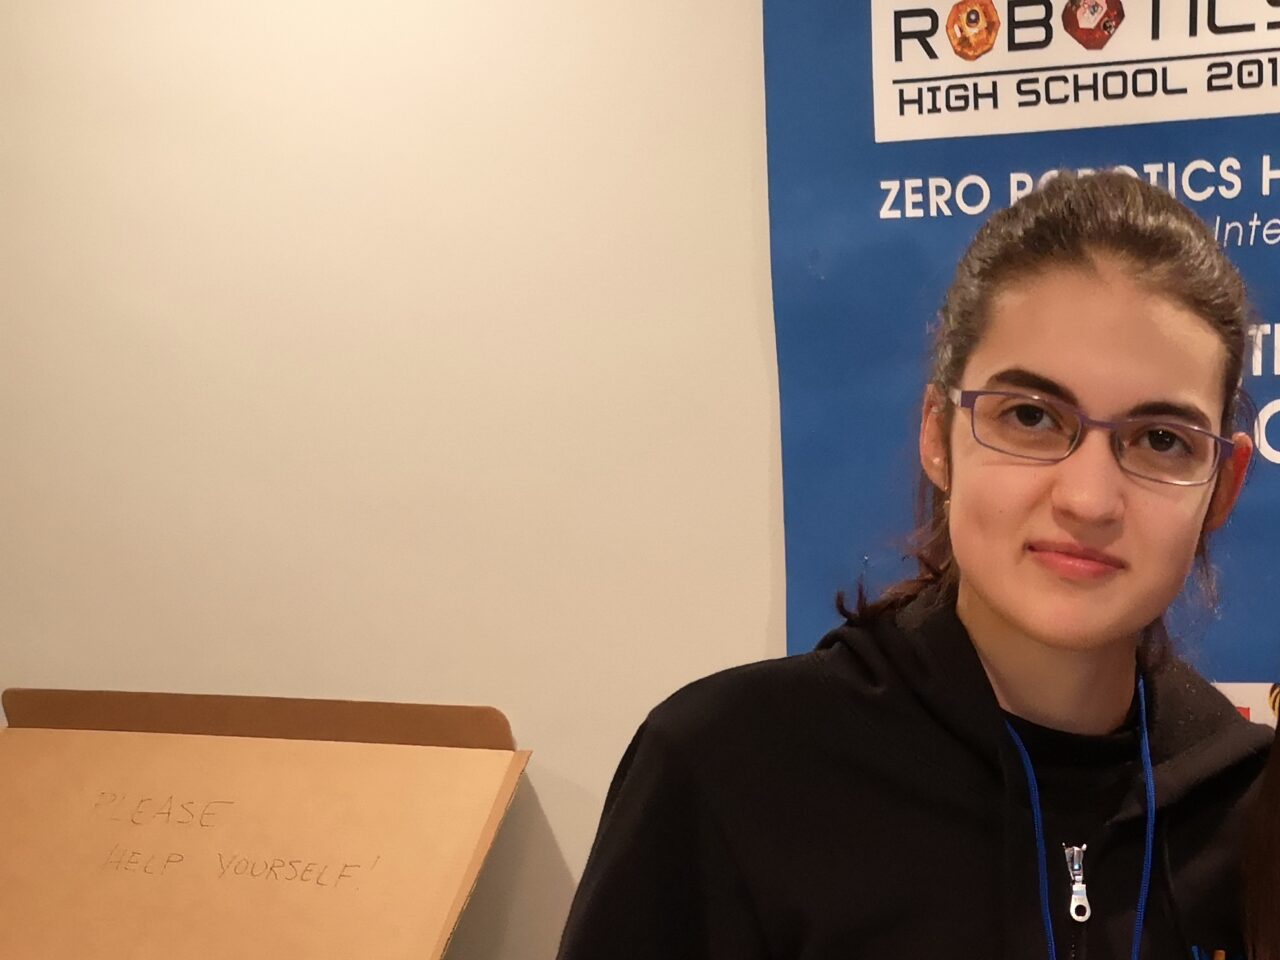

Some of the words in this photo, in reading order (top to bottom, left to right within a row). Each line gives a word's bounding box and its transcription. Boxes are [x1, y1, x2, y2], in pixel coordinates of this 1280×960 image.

[898, 81, 998, 116] HIGH
[1016, 67, 1188, 108] SCHOOL
[880, 176, 991, 219] ZERO
[101, 843, 185, 876] HELP
